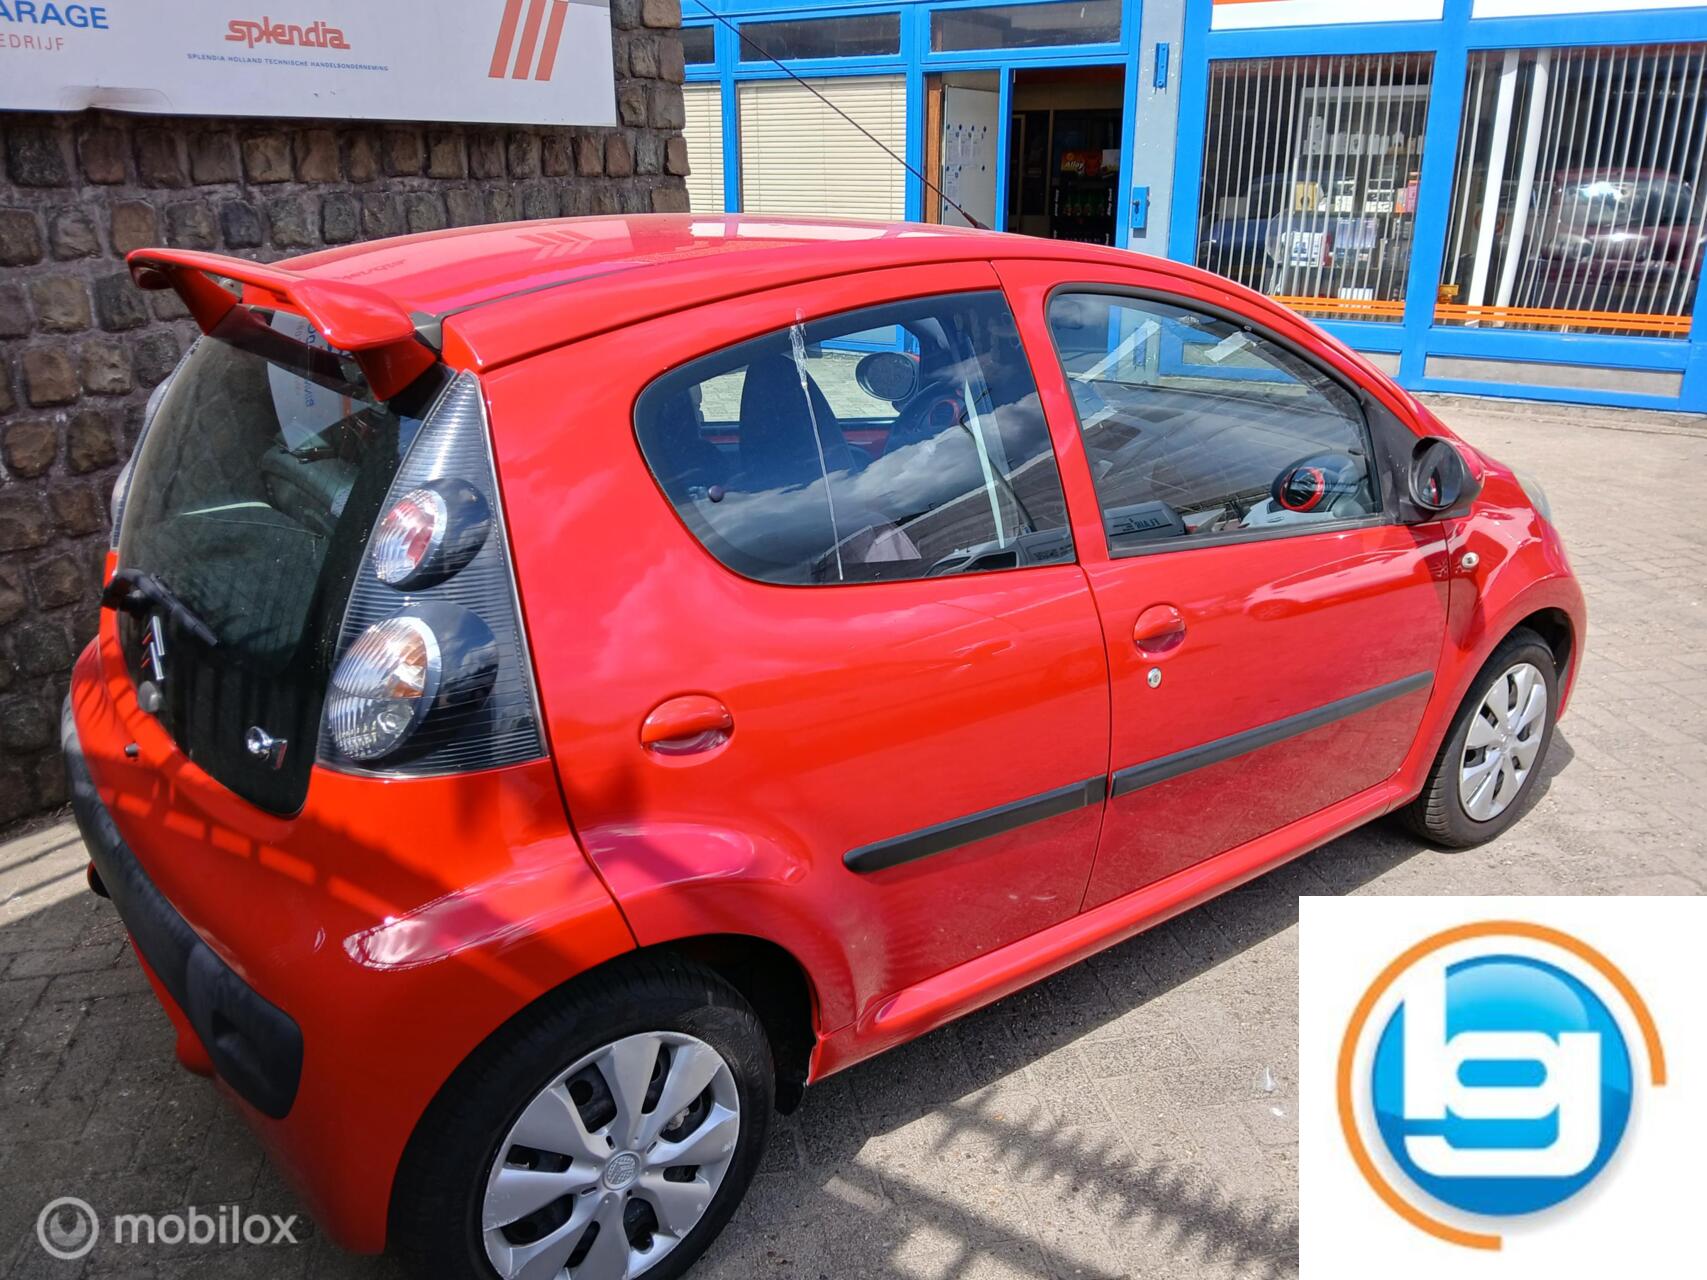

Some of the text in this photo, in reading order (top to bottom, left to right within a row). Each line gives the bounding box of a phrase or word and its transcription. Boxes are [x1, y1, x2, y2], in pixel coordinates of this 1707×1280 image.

[224, 16, 351, 49] splendia
[187, 53, 389, 71] SPLENDIA HOLLAND TECHNISCHE HANDELSONDERNEMING
